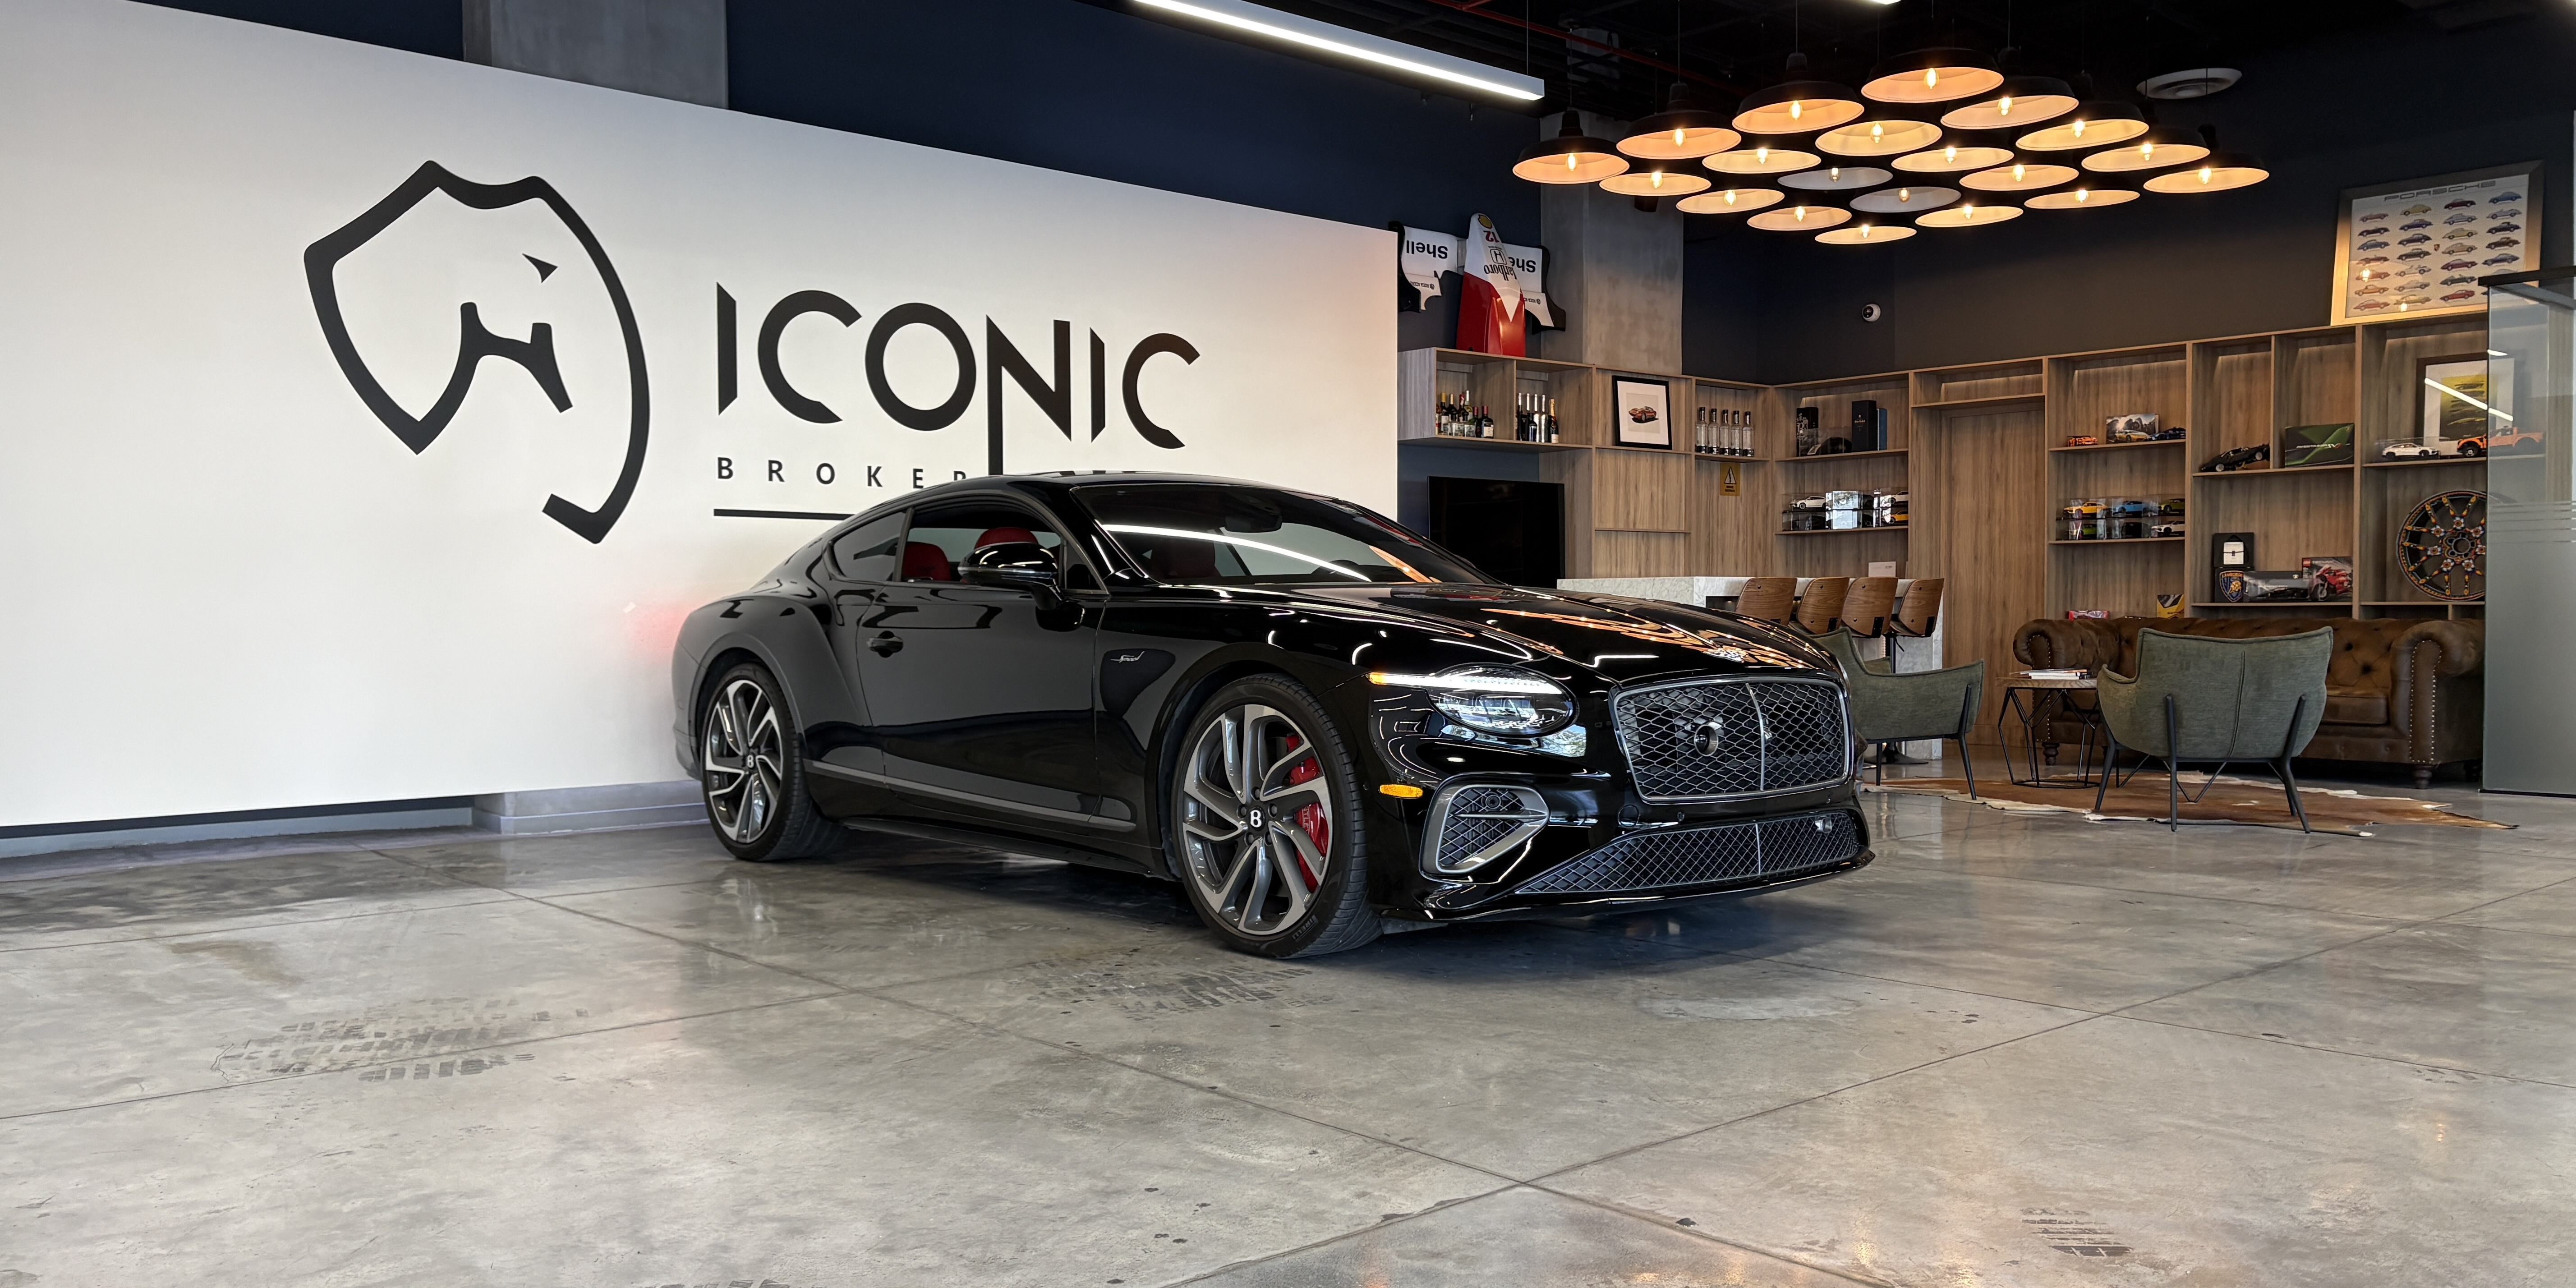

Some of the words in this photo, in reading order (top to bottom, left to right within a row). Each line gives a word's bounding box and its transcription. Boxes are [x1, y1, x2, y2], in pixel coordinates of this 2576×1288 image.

[2384, 180, 2496, 201] PORSCHE
[1483, 230, 1499, 243] 12
[1407, 240, 1448, 259] Shell
[1508, 257, 1536, 273] She
[716, 282, 1201, 475] ICONIC
[1250, 810, 1262, 828] B
